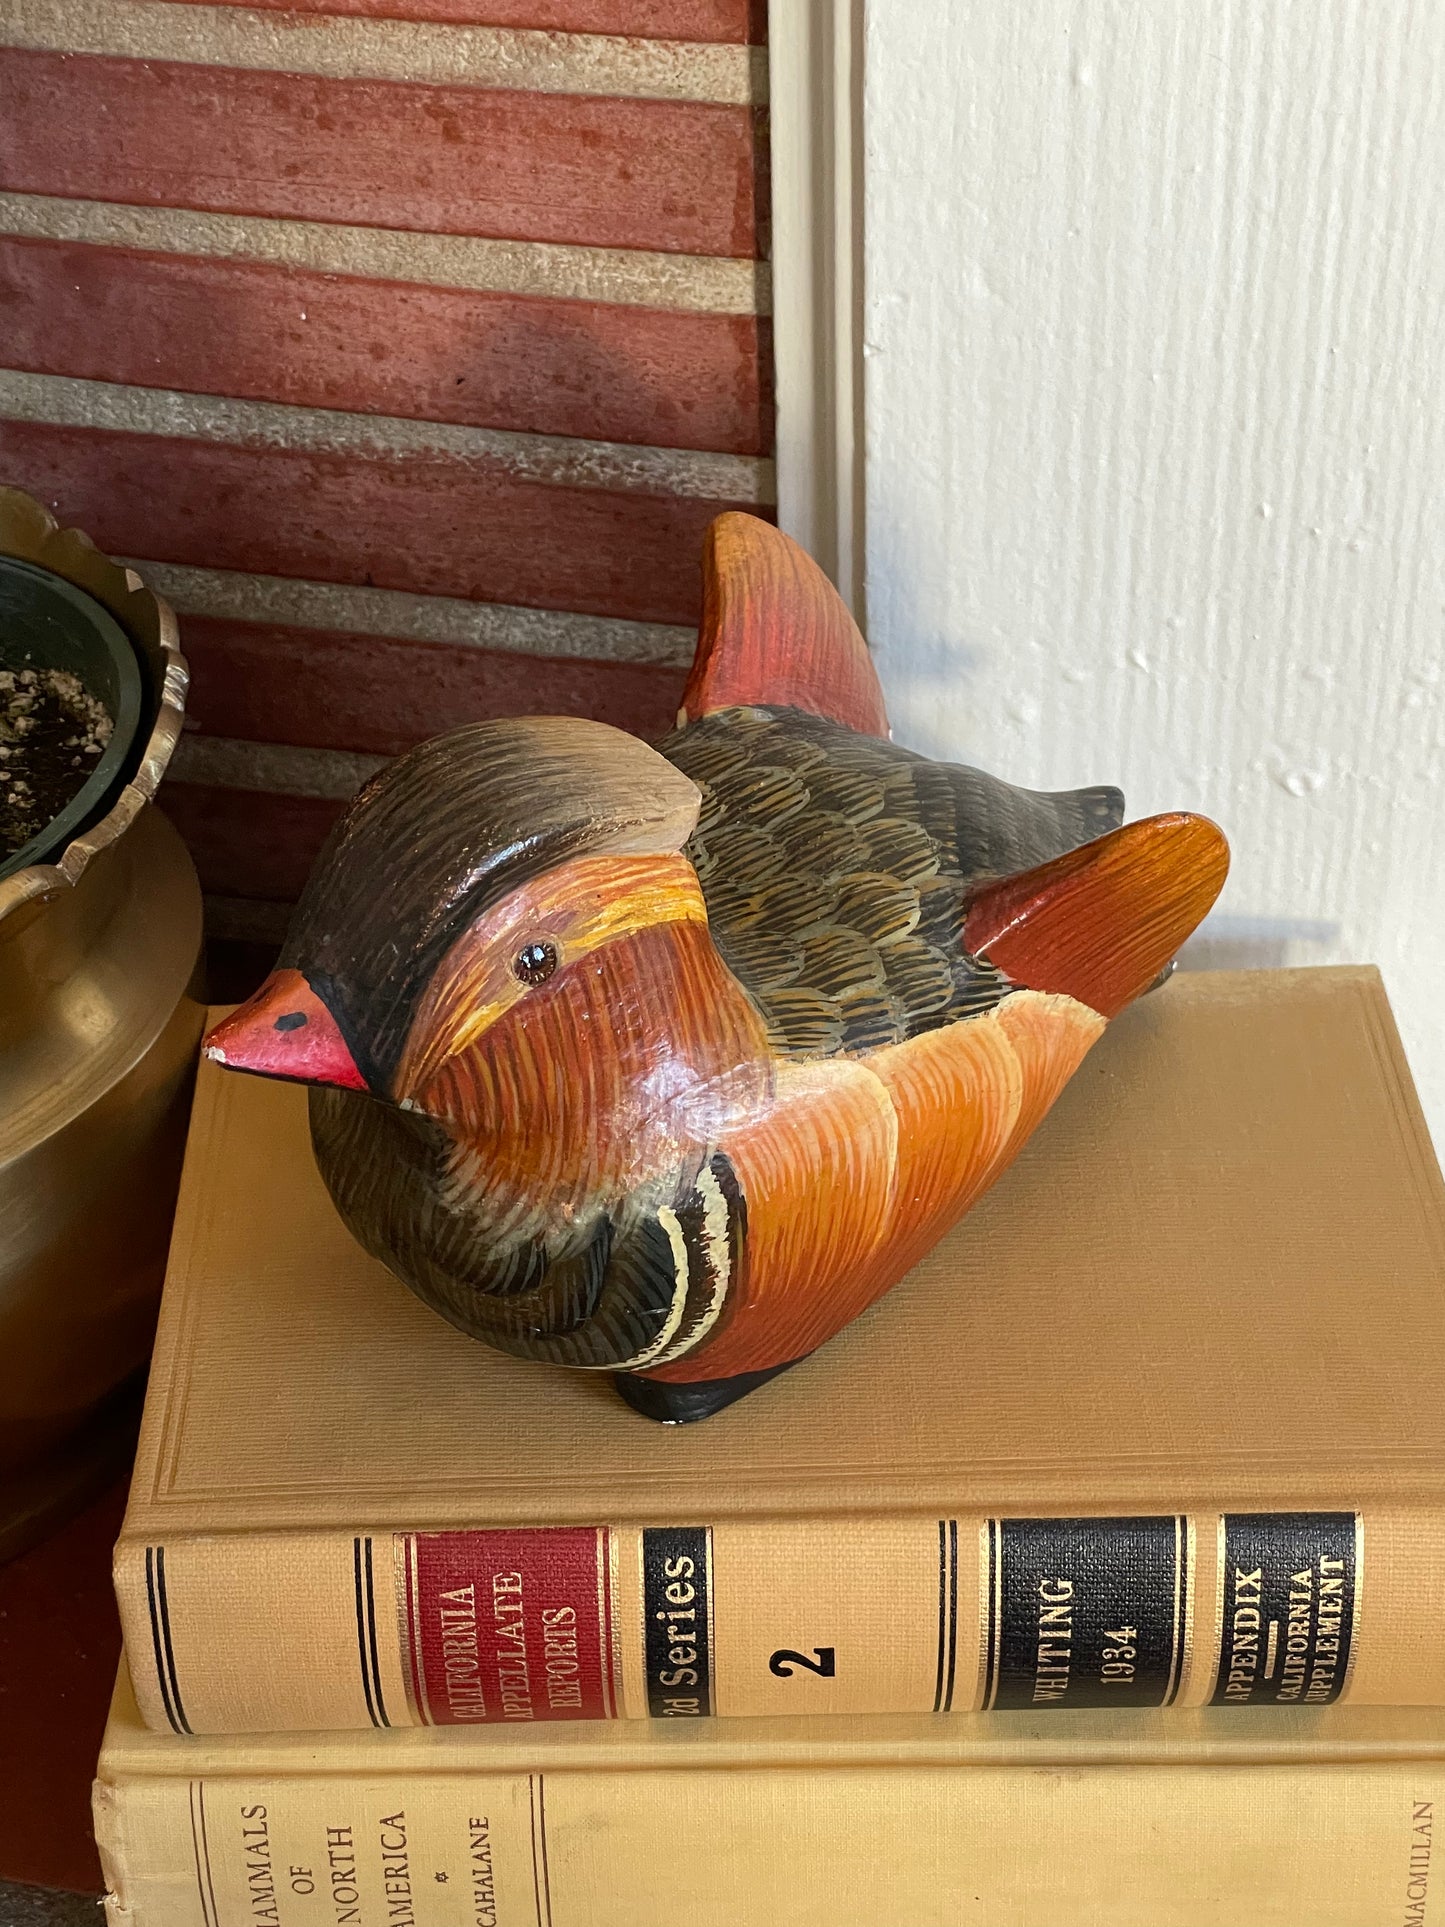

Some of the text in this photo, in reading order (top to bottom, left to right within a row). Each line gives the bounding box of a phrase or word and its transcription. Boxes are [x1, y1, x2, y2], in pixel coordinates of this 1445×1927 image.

[440, 1583, 486, 1718] CALIFORNIA
[492, 1571, 534, 1719] APPELLATE
[541, 1606, 582, 1708] REPORTS
[656, 1555, 698, 1686] Series
[769, 1647, 835, 1677] 2
[1032, 1578, 1074, 1702] WHITING
[1100, 1626, 1138, 1684] 1934
[1224, 1567, 1262, 1700] APPENDIX
[1276, 1568, 1313, 1700] CALIFORNIA
[1303, 1554, 1344, 1702] SUPPLEMENT
[240, 1804, 280, 1927] AMMALS
[289, 1865, 315, 1894] OF
[326, 1826, 361, 1924] NORTH
[469, 1816, 497, 1927] CAHALANE
[1403, 1800, 1434, 1927] MACMILLAN
